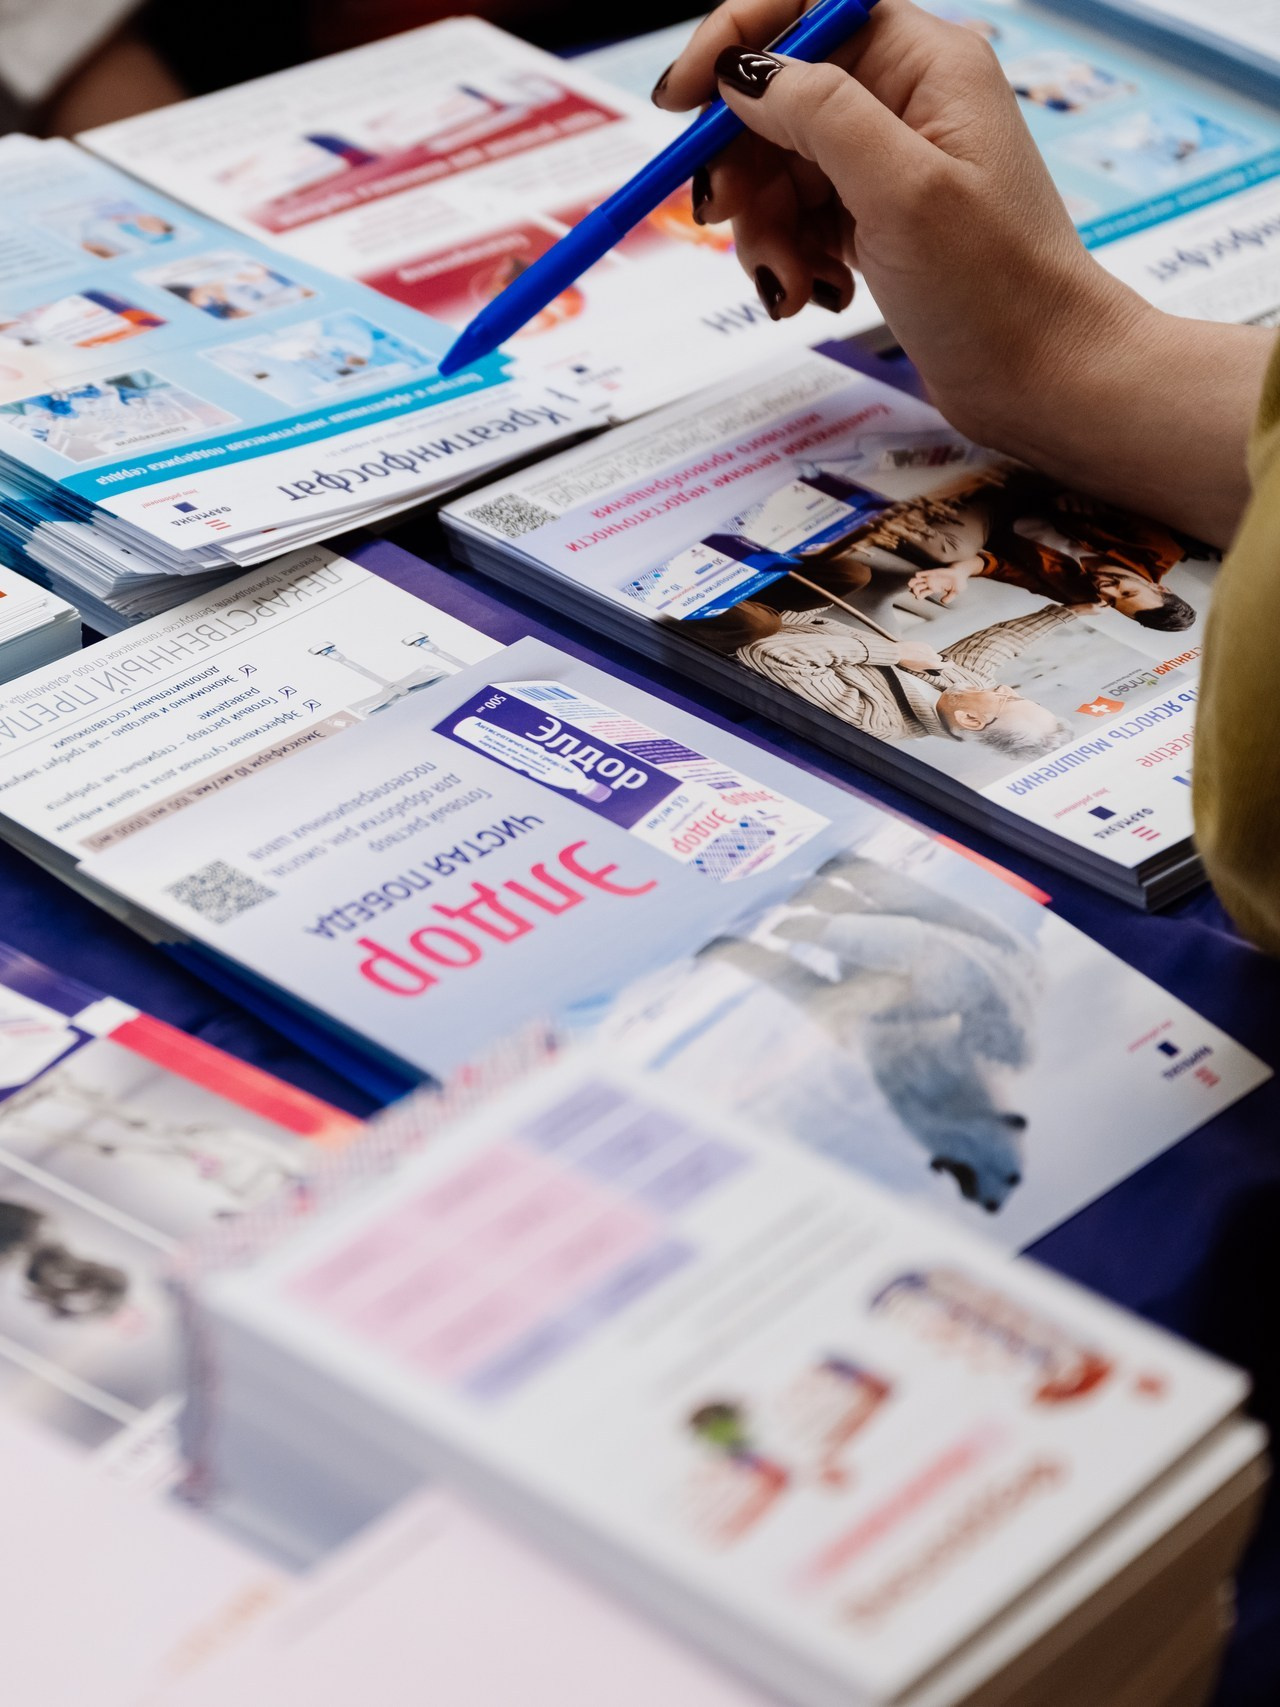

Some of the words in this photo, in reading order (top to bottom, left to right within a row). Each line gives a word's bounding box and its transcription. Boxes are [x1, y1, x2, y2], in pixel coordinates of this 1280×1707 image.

[147, 446, 226, 471] поддержка
[279, 407, 569, 501] Креатинфосфат
[714, 450, 785, 487] лечение
[95, 467, 148, 486] сердца
[592, 450, 742, 518] кровообращения
[170, 506, 232, 527] ФАРМЛЭНД
[566, 484, 711, 552] недостаточности
[279, 553, 323, 579] Реклама.
[702, 566, 749, 594] Винпоцетин
[681, 592, 706, 607] Форте
[93, 562, 340, 693] ЛЕКАРСТВЕННЫЙ
[108, 605, 217, 659] Белорусско-голландское
[71, 664, 96, 677] ООО
[91, 657, 109, 668] СП
[130, 665, 220, 712] дополнительных
[168, 674, 239, 709] Экономично
[484, 693, 507, 710] 500
[1108, 672, 1160, 697] Linnea
[158, 706, 170, 714] и
[198, 686, 261, 720] разведение
[230, 696, 279, 721] Готовый
[1108, 700, 1184, 740] ясность
[52, 709, 131, 749] составляющих
[111, 711, 160, 737] выгодно
[186, 716, 231, 742] раствор
[227, 710, 303, 747] Эффективная
[42, 747, 87, 771] требует
[86, 739, 102, 749] не
[178, 745, 228, 772] суточная
[249, 730, 326, 768] Эмоксифарм
[526, 717, 648, 790] Элдор
[233, 766, 253, 777] 10
[430, 772, 462, 793] для
[1006, 738, 1113, 796] мышления
[292, 762, 437, 838] послеоперационных
[358, 789, 434, 832] обработки
[427, 787, 493, 823] Готовый
[368, 816, 431, 852] раствор
[424, 815, 543, 876] ЧИСТАЯ
[671, 808, 746, 854] Элдор
[307, 870, 433, 939] ПОБЕДА
[358, 842, 655, 997] Элдор
